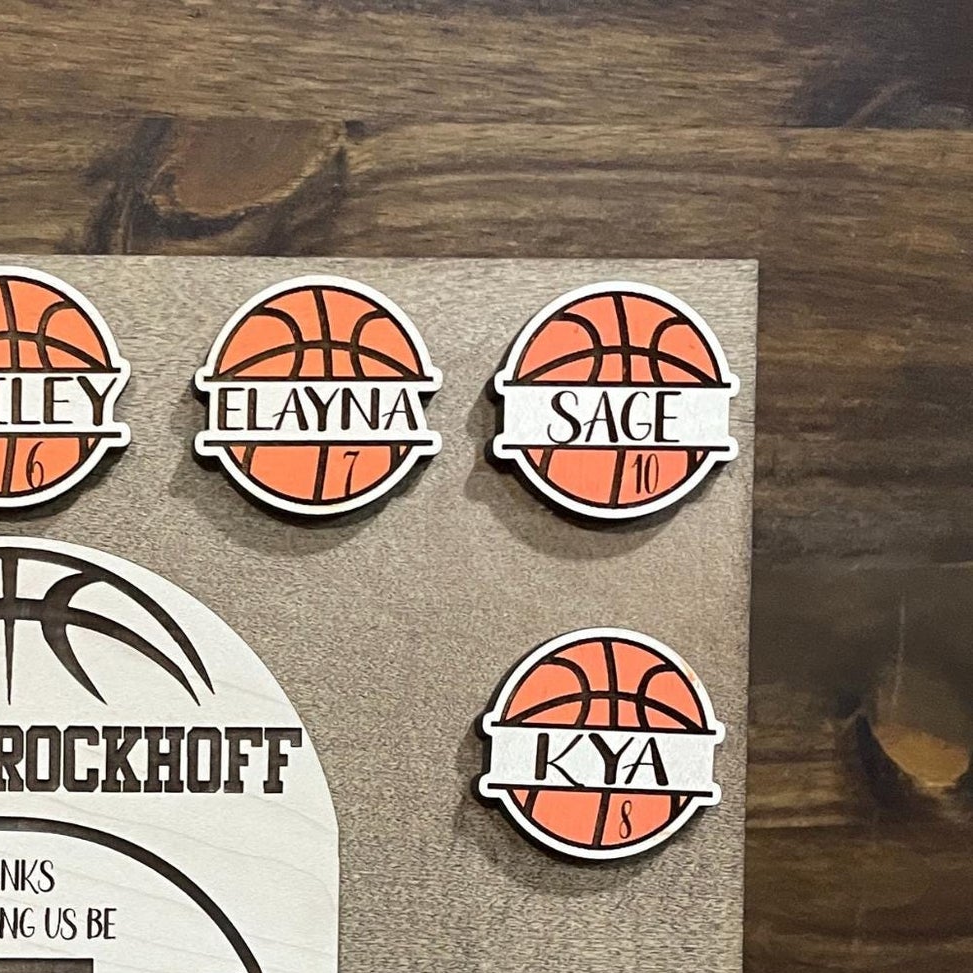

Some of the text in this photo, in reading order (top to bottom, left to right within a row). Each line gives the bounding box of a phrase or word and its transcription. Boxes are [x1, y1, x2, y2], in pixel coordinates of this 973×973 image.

[218, 386, 418, 433] ELAYNA
[546, 390, 682, 444] SAGE
[25, 441, 45, 488] 6
[342, 451, 361, 496] 7
[631, 453, 659, 494] 10
[534, 732, 669, 787] KYA
[618, 800, 633, 839] 8
[44, 907, 79, 941] US
[87, 908, 118, 940] BE
